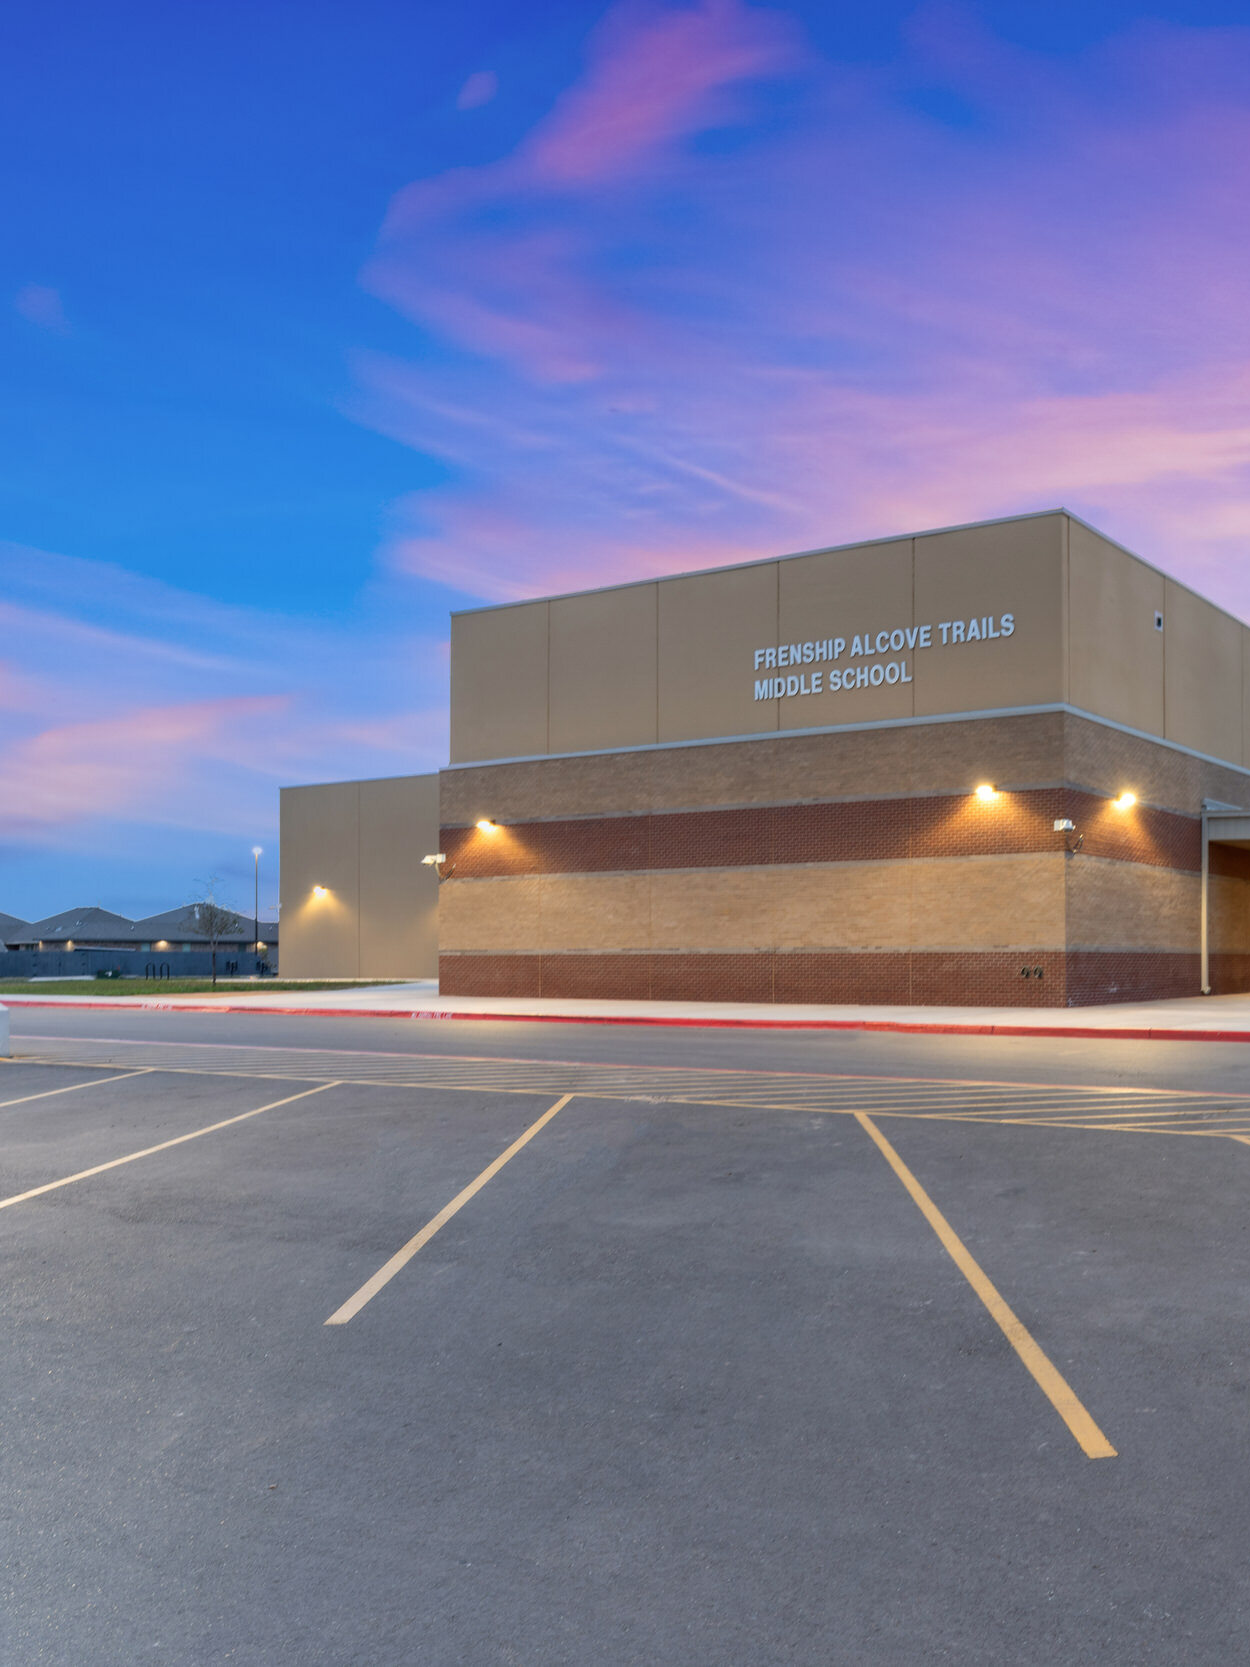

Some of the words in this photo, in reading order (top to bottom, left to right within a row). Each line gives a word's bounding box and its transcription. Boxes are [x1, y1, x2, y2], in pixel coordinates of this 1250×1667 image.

[754, 638, 846, 670] FRENSHIP
[850, 625, 932, 657] ALCOVE
[938, 613, 1016, 645] TRAILS
[754, 672, 823, 701] MIDDLE
[829, 661, 912, 692] SCHOOL
